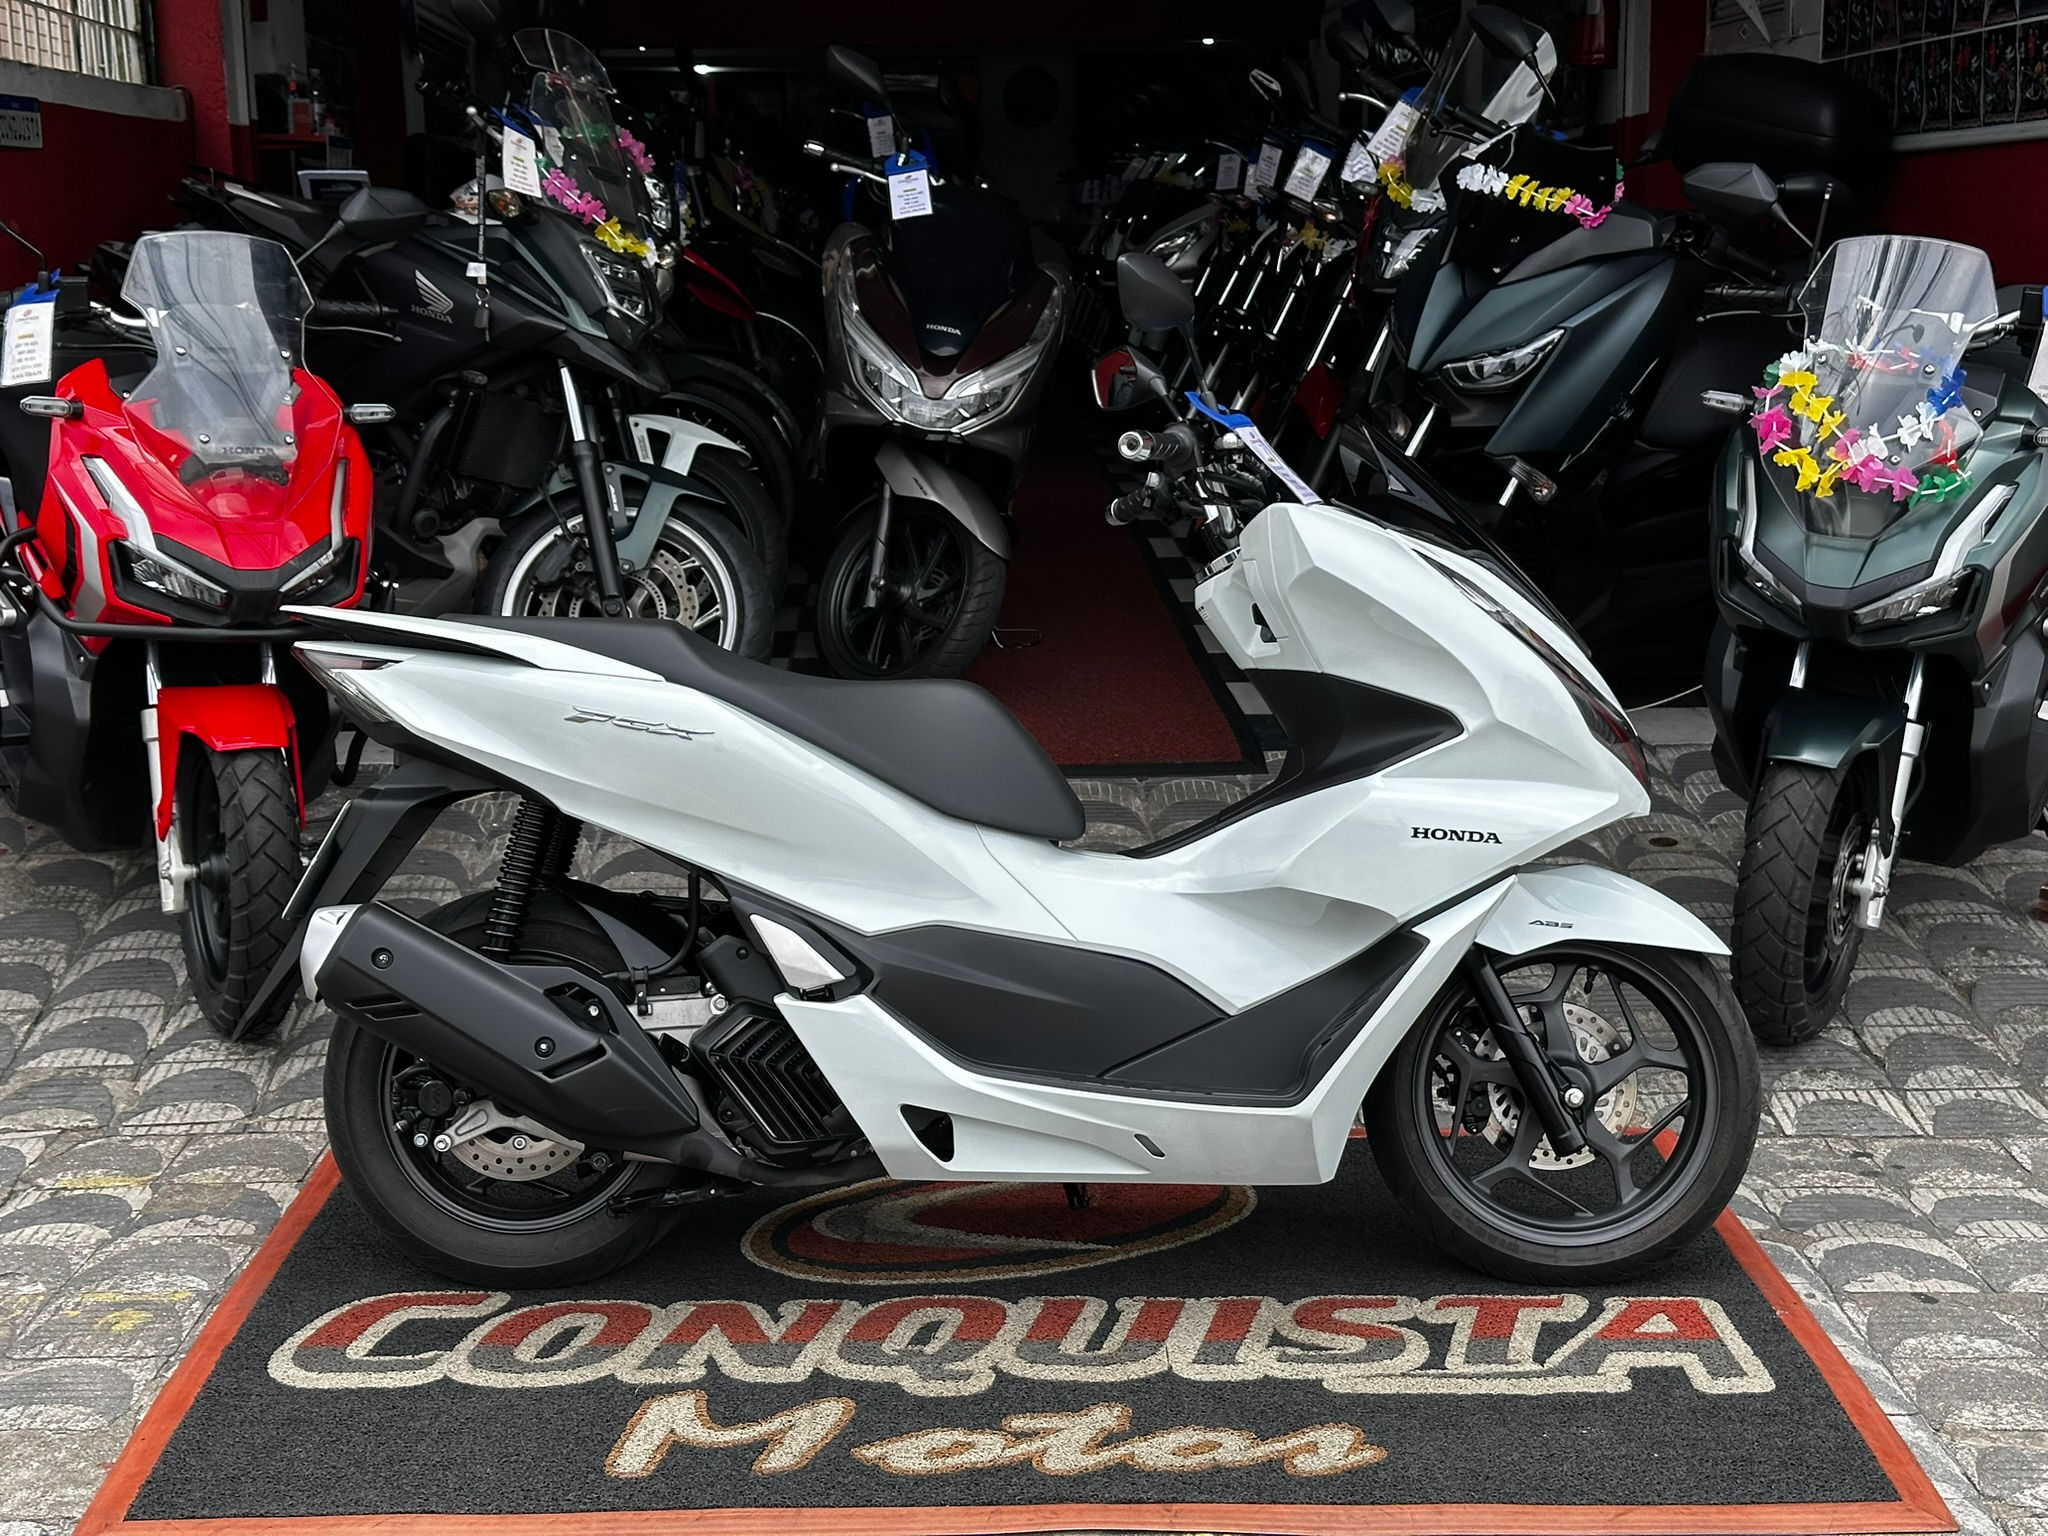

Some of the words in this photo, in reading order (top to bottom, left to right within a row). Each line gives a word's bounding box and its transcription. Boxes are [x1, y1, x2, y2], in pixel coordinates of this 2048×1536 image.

[410, 304, 454, 324] HONDA
[925, 323, 962, 336] HONDA
[222, 446, 276, 456] HONDA
[564, 705, 715, 741] PCX
[1410, 826, 1503, 845] HONDA
[1528, 919, 1575, 929] ABS
[267, 1290, 1776, 1397] CONQUISTA
[604, 1389, 1388, 1478] Motos
